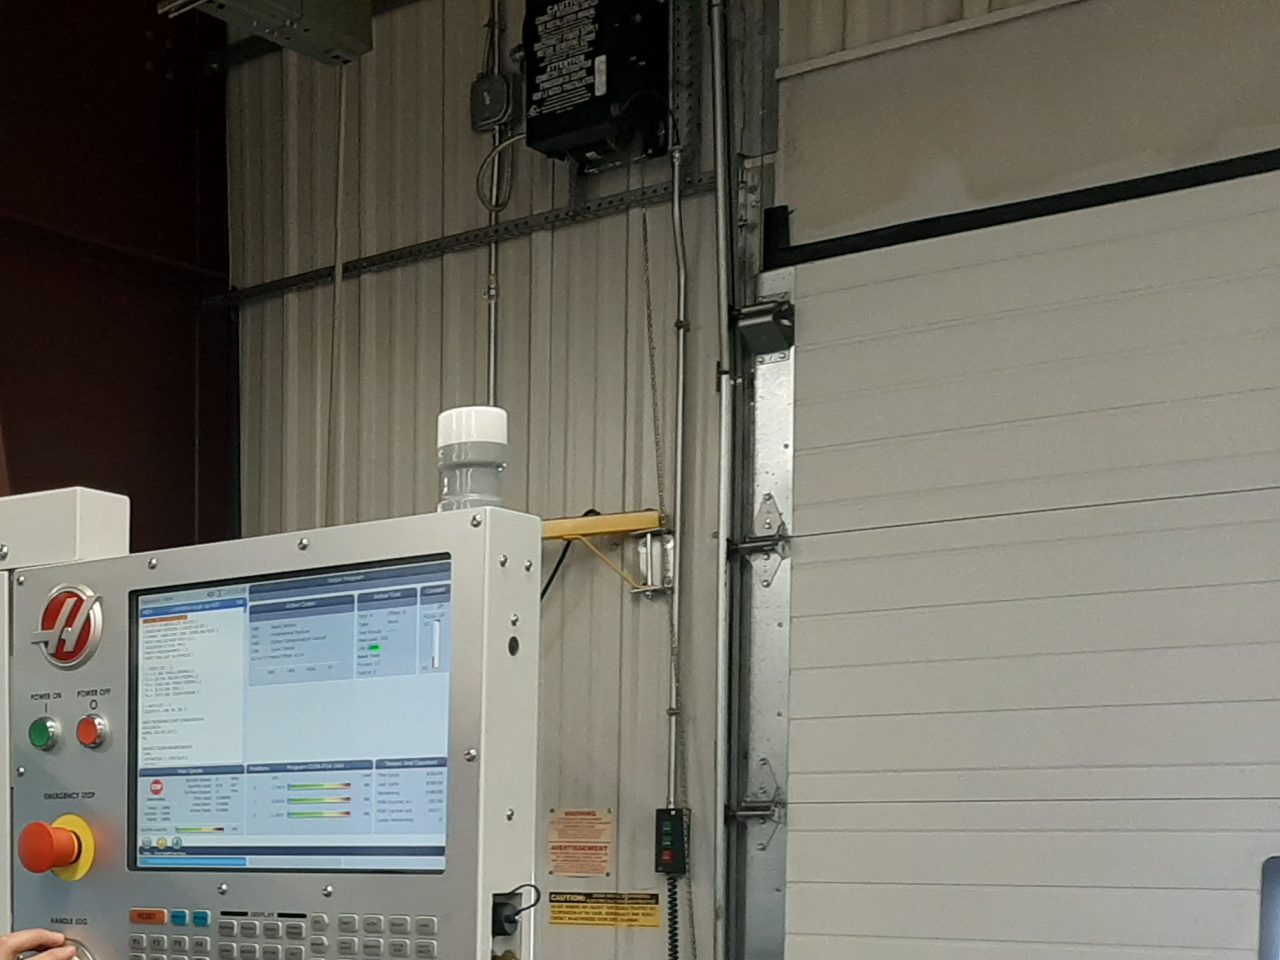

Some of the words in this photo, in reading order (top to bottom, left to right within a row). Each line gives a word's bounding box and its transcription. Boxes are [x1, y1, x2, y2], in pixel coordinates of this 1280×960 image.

[52, 692, 62, 700] ON
[77, 689, 98, 697] POWER
[100, 688, 111, 696] OFF
[50, 917, 73, 925] HANDLE
